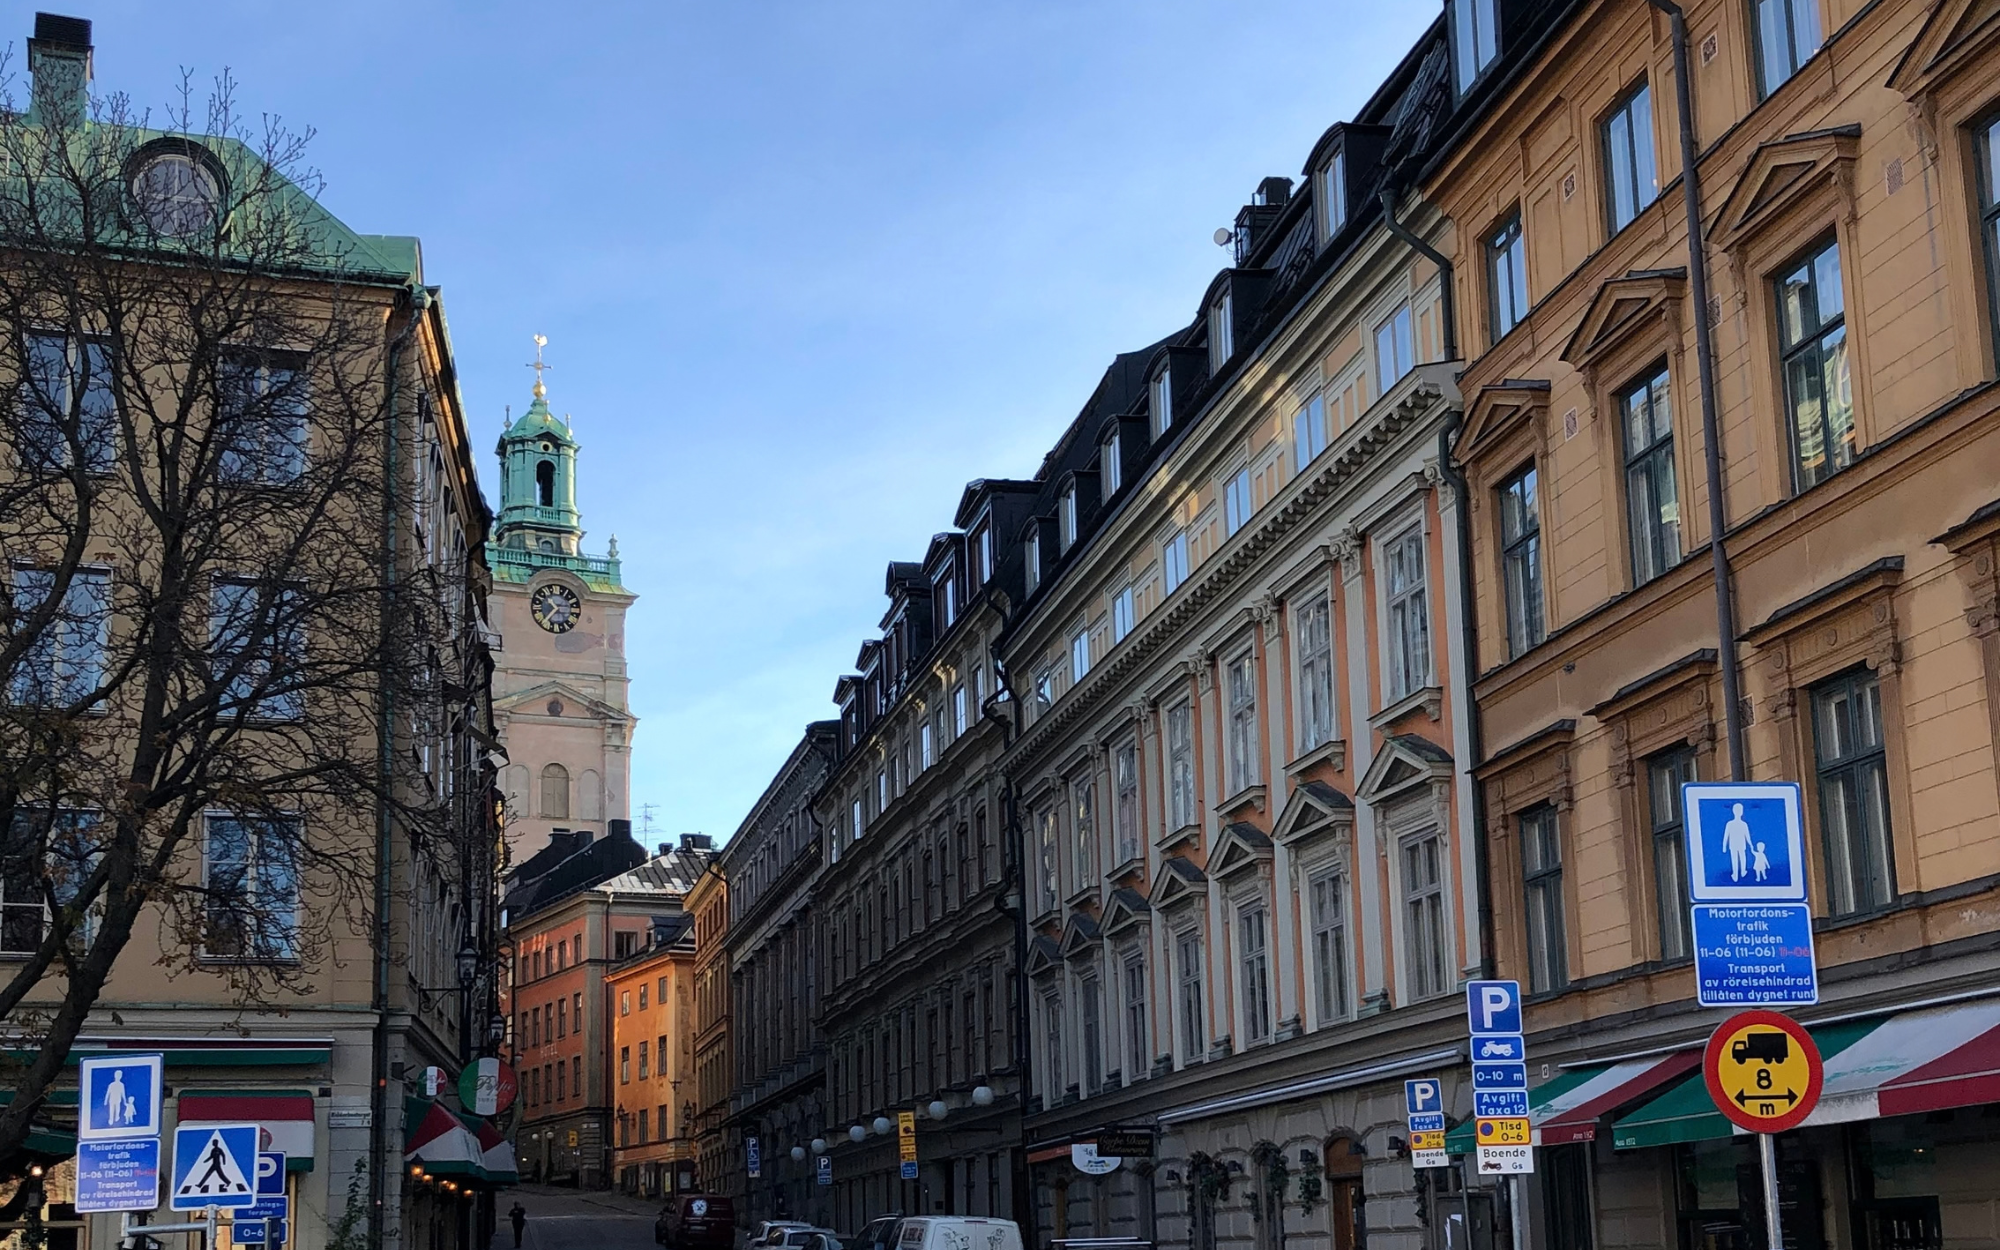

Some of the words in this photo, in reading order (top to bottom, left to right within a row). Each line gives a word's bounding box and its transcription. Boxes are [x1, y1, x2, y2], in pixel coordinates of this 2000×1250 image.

[1708, 908, 1795, 918] Motorfordons-
[1736, 921, 1769, 931] trafik
[1726, 934, 1783, 946] förbjuden
[1700, 947, 1732, 958] 11-06
[1736, 946, 1776, 958] (11-06)
[1728, 963, 1786, 974] Transport
[1704, 979, 1718, 987] av
[1723, 976, 1811, 986] rörelsehindrad
[1702, 990, 1744, 1000] tillåten
[1748, 990, 1788, 1001] dygnet
[1792, 990, 1814, 1000] runt
[1481, 986, 1510, 1028] P
[1476, 1070, 1504, 1080] 0-10
[1514, 1072, 1523, 1080] m
[1756, 1068, 1772, 1090] 8
[1414, 1082, 1434, 1110] P
[1482, 1092, 1520, 1106] Avgift
[1480, 1105, 1511, 1115] Taxa
[1514, 1104, 1526, 1114] 12
[1760, 1102, 1775, 1116] m
[1414, 1116, 1438, 1124] Avgift
[1499, 1121, 1522, 1130] Tisd
[1501, 1132, 1524, 1141] 0-6
[749, 1138, 756, 1148] P
[1416, 1150, 1444, 1158] Boende
[1483, 1148, 1526, 1158] Boende
[820, 1158, 828, 1169] P
[1512, 1162, 1524, 1170] Gs
[98, 1180, 138, 1188] Transport
